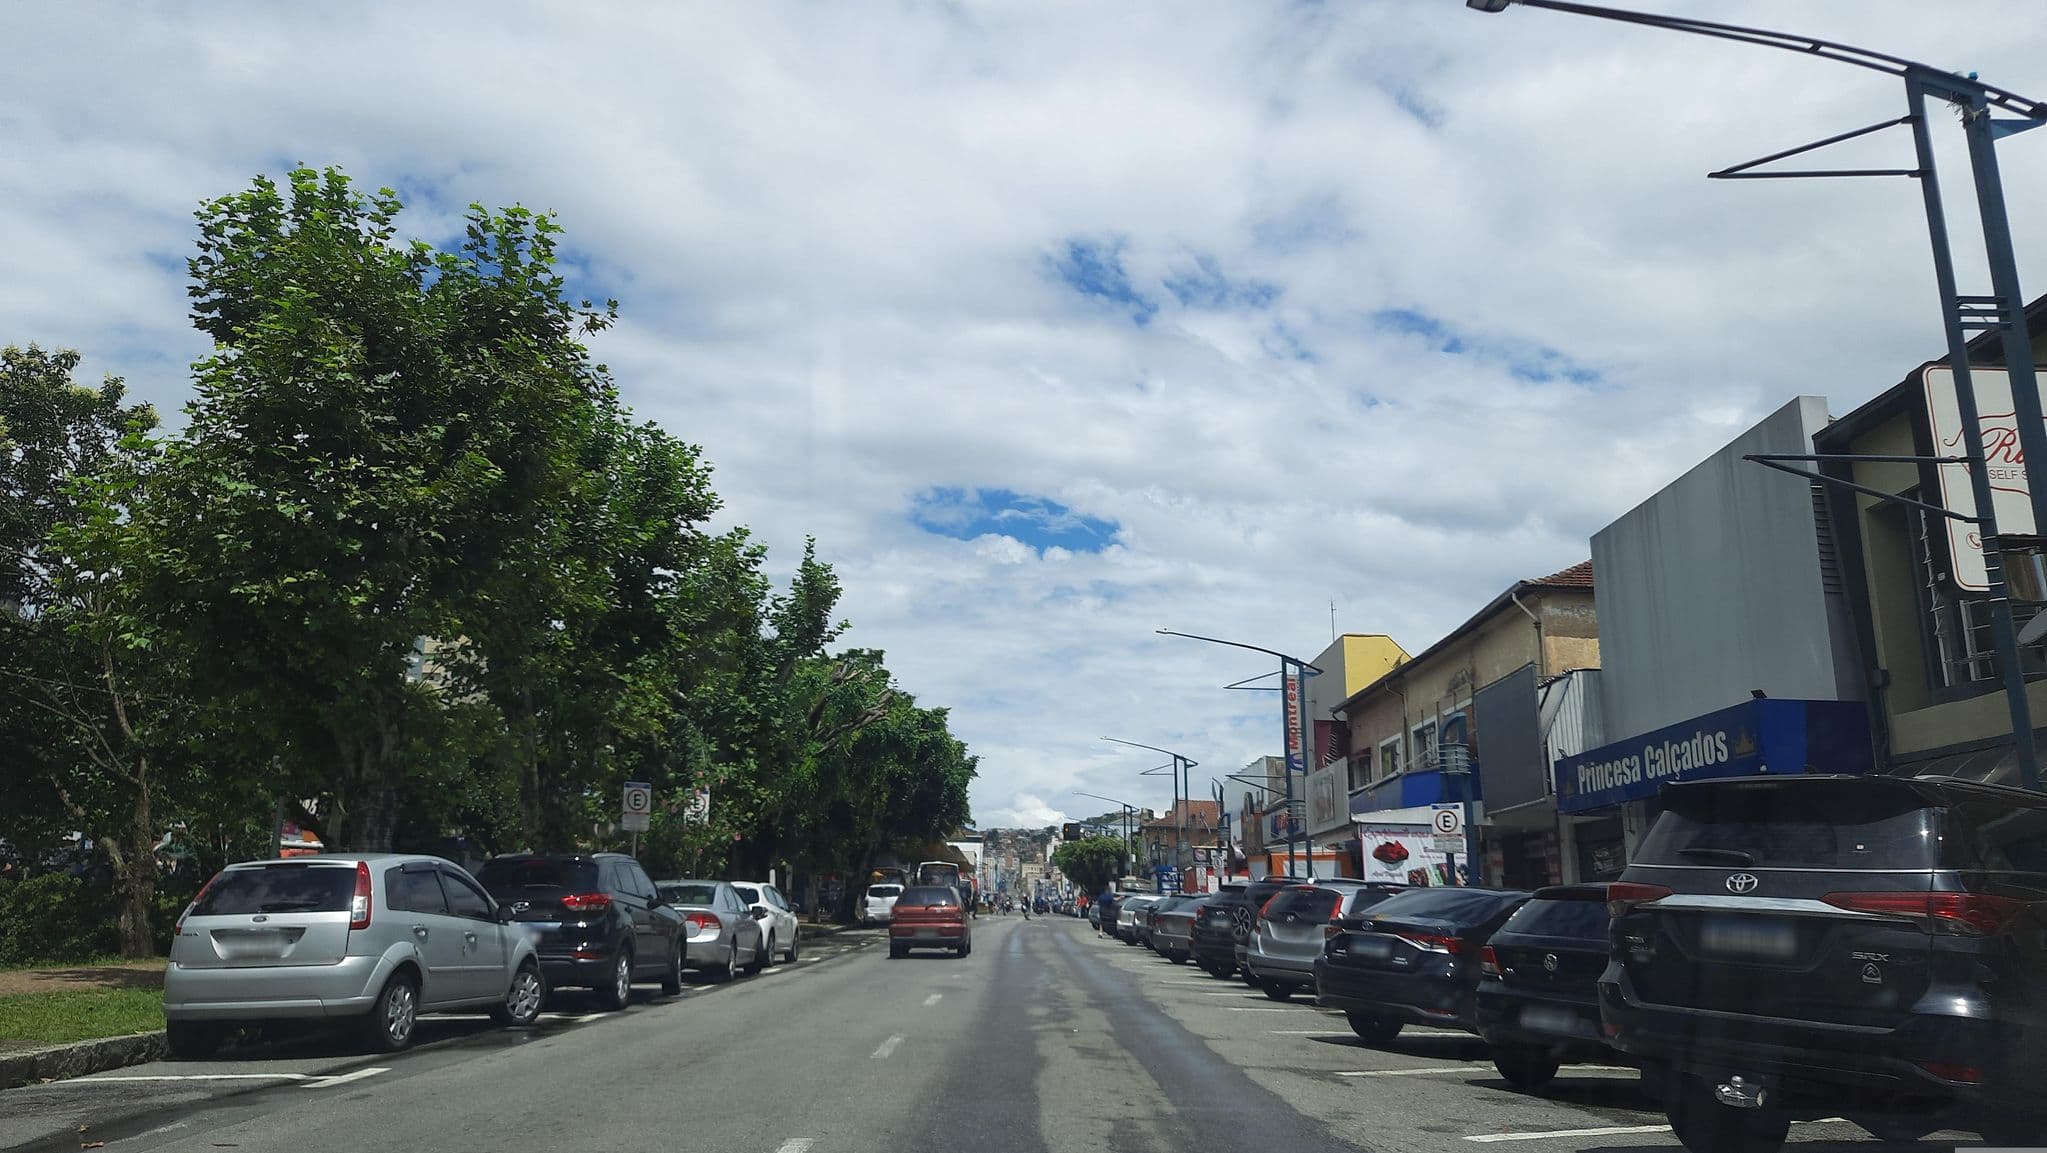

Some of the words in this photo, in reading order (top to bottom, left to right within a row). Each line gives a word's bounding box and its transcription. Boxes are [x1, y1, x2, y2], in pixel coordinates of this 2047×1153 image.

[1989, 469, 2017, 480] SELF
[1287, 678, 1299, 750] Montreal
[1578, 755, 1641, 795] Princesa
[1644, 730, 1728, 780] Calçados
[634, 794, 641, 807] E
[1442, 815, 1452, 828] E
